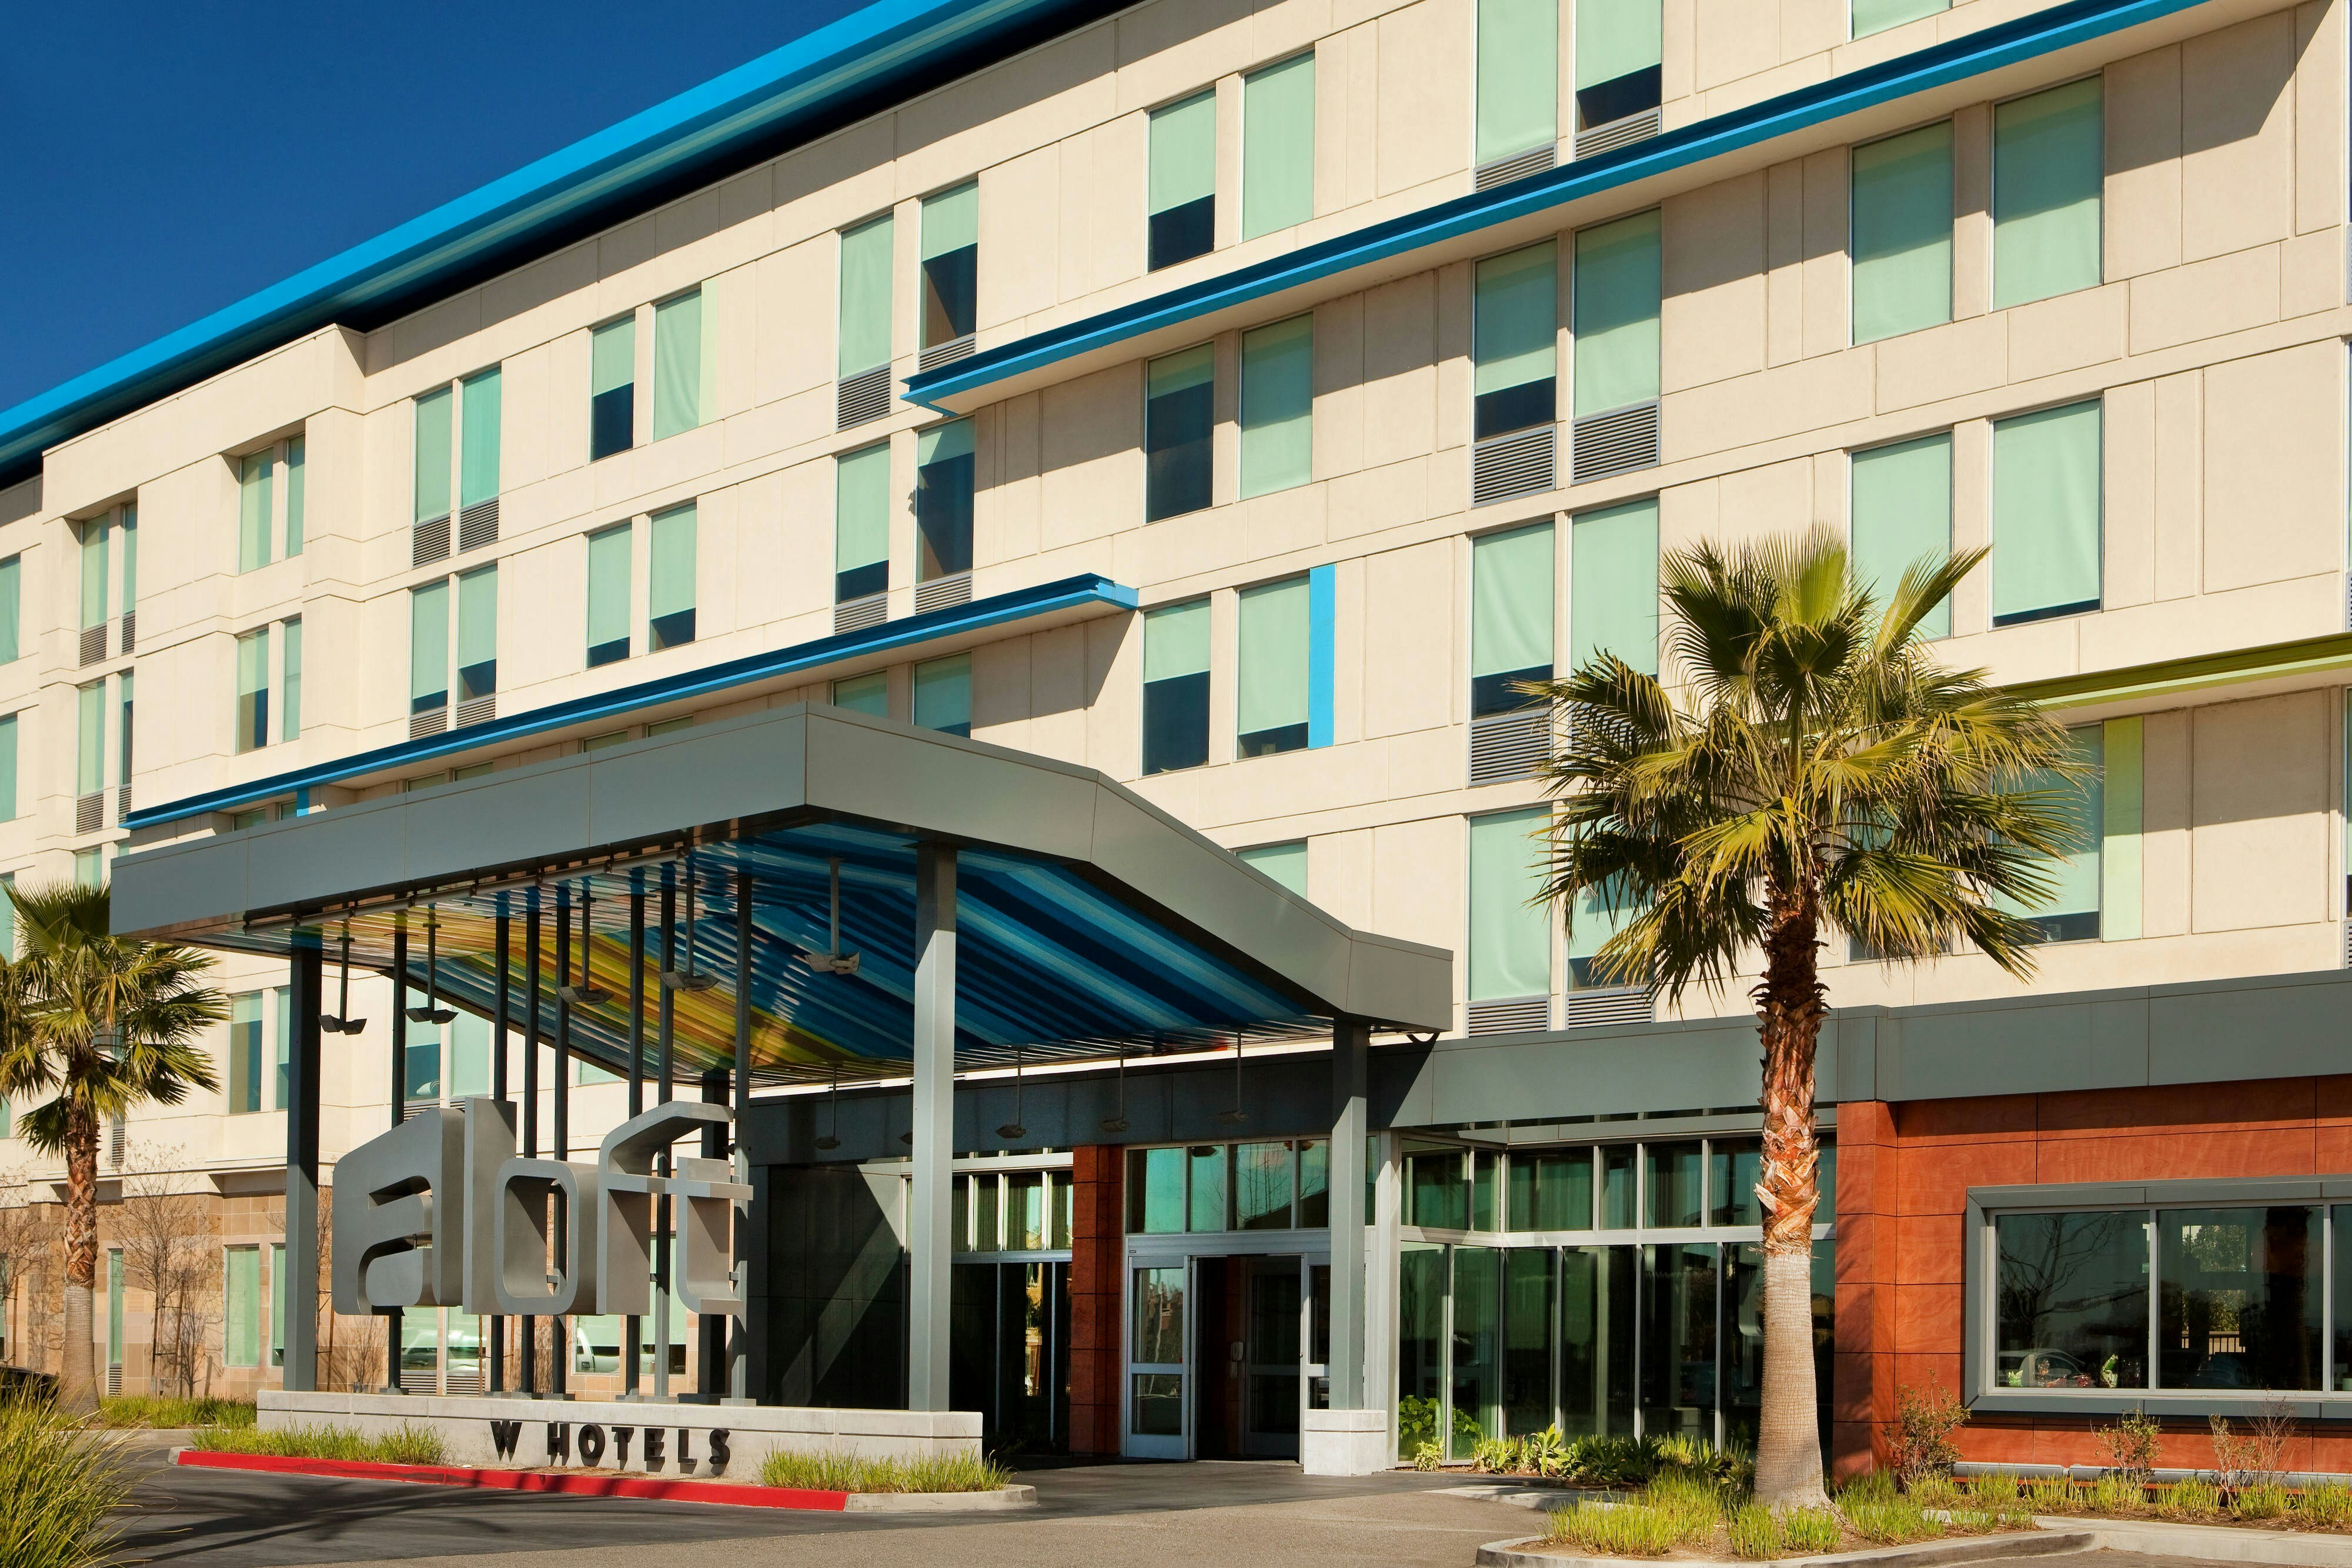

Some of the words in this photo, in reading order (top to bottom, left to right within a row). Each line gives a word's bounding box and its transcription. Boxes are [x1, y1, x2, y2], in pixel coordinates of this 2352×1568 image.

[332, 1097, 753, 1315] aloft
[490, 1420, 522, 1457] W
[547, 1422, 731, 1465] HOTELS
